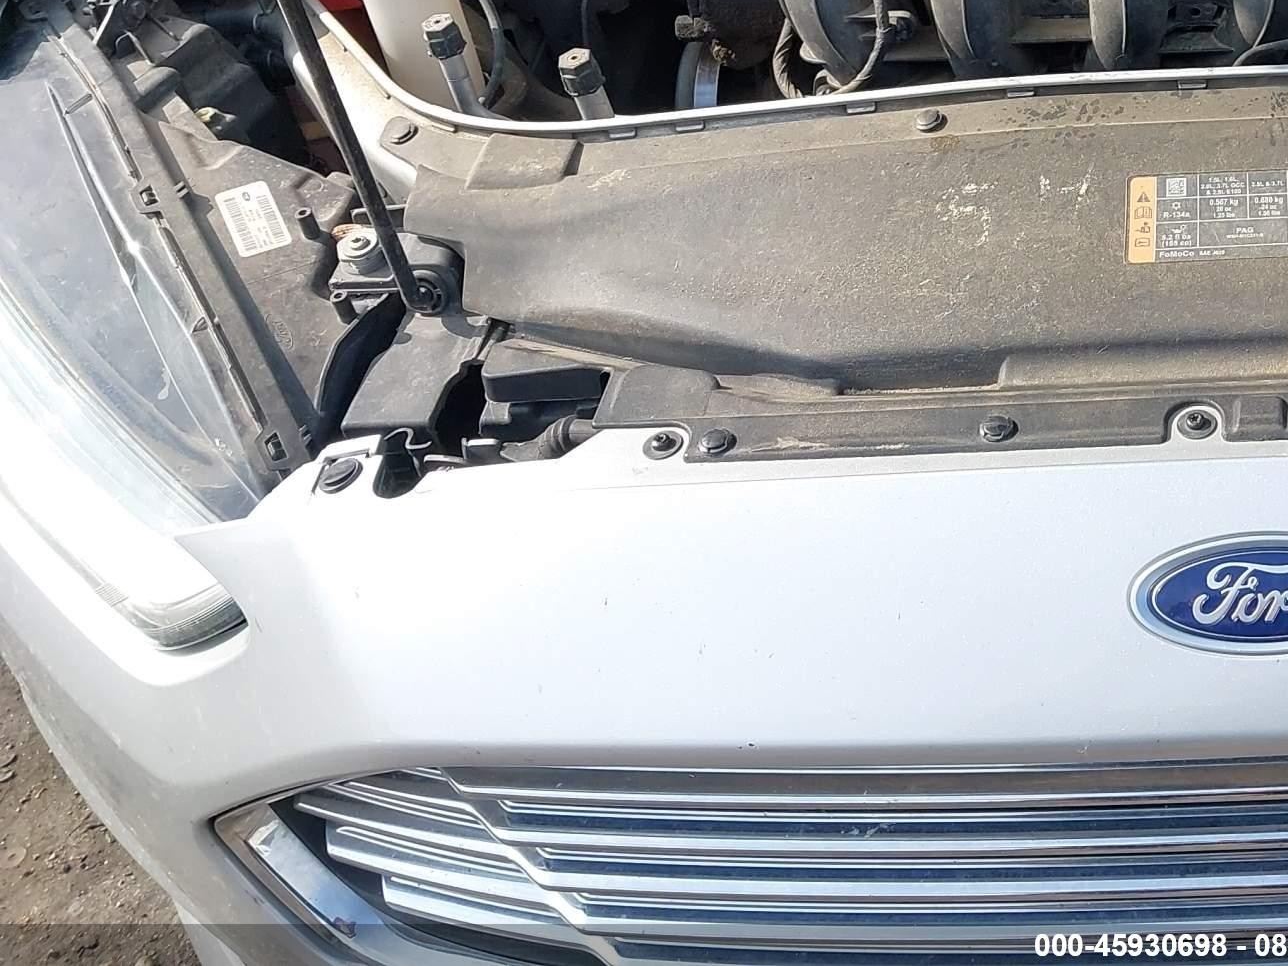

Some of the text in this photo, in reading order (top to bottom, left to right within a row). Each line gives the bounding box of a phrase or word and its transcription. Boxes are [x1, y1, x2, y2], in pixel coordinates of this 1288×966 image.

[1229, 198, 1239, 207] kg
[1274, 196, 1284, 205] kg
[1159, 250, 1195, 258] FoMoCo
